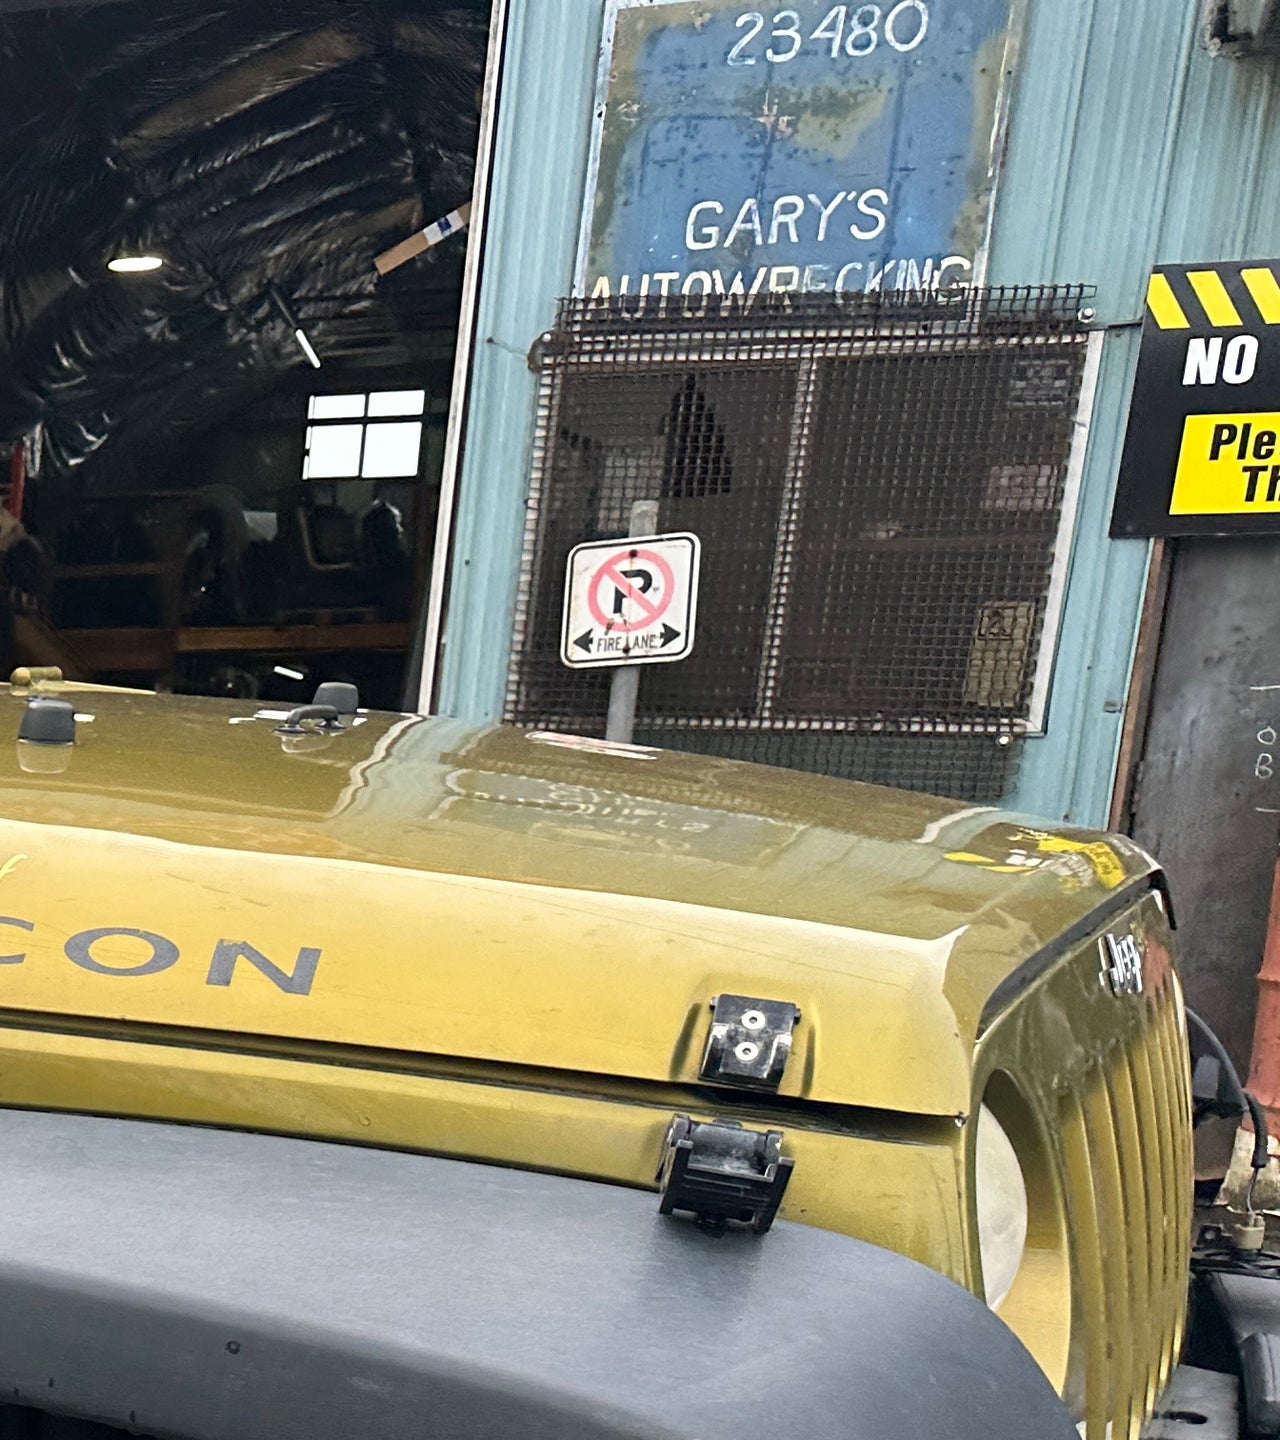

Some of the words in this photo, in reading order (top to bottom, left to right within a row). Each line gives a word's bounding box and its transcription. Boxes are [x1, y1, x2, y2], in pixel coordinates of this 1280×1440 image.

[727, 0, 929, 66] 23480
[685, 189, 889, 251] GARY'S
[1182, 334, 1259, 386] NO
[1209, 423, 1280, 461] Ple
[597, 636, 622, 652] FIRE
